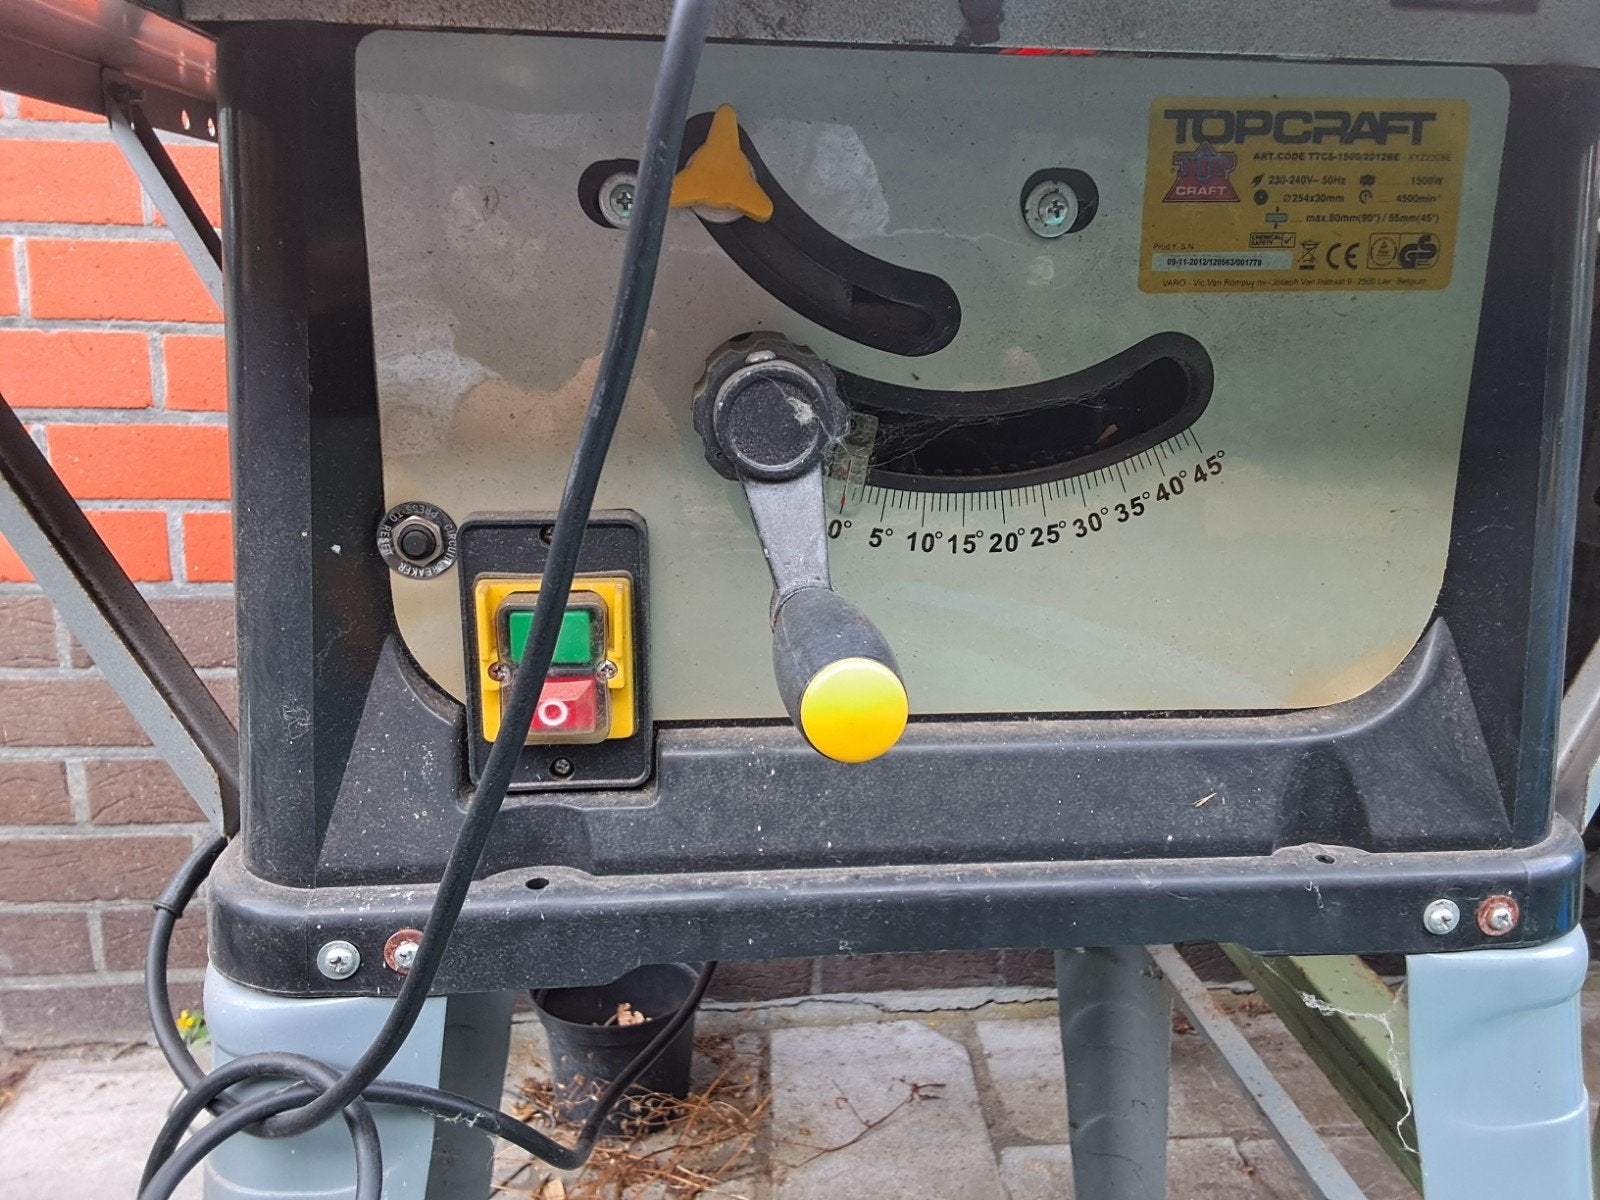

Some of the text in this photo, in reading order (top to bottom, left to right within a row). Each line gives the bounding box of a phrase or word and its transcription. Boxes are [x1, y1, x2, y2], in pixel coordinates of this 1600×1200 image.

[1164, 109, 1437, 145] TOPCRAFT
[1253, 152, 1305, 161] ART.CODE
[1322, 176, 1346, 185] 50Hz
[1411, 176, 1444, 185] 1500W
[1175, 185, 1228, 196] CRAFT
[1326, 242, 1360, 270] CE
[1162, 278, 1186, 287] VARO
[1193, 278, 1205, 287] Vic
[1207, 278, 1222, 287] Van
[1223, 277, 1255, 288] Rompuy
[1300, 278, 1315, 286] Van
[868, 528, 893, 548] 5°
[907, 531, 943, 553] 10°
[947, 530, 984, 554] 15°
[989, 528, 1026, 553] 20°
[1030, 520, 1067, 547] 25°
[1072, 507, 1109, 538] 30°
[1114, 491, 1150, 523] 35°
[1155, 470, 1187, 502] 40°
[1193, 450, 1225, 483] 45°
[379, 504, 439, 556] PRESS TO RESET
[443, 523, 457, 566] CIRCUIT
